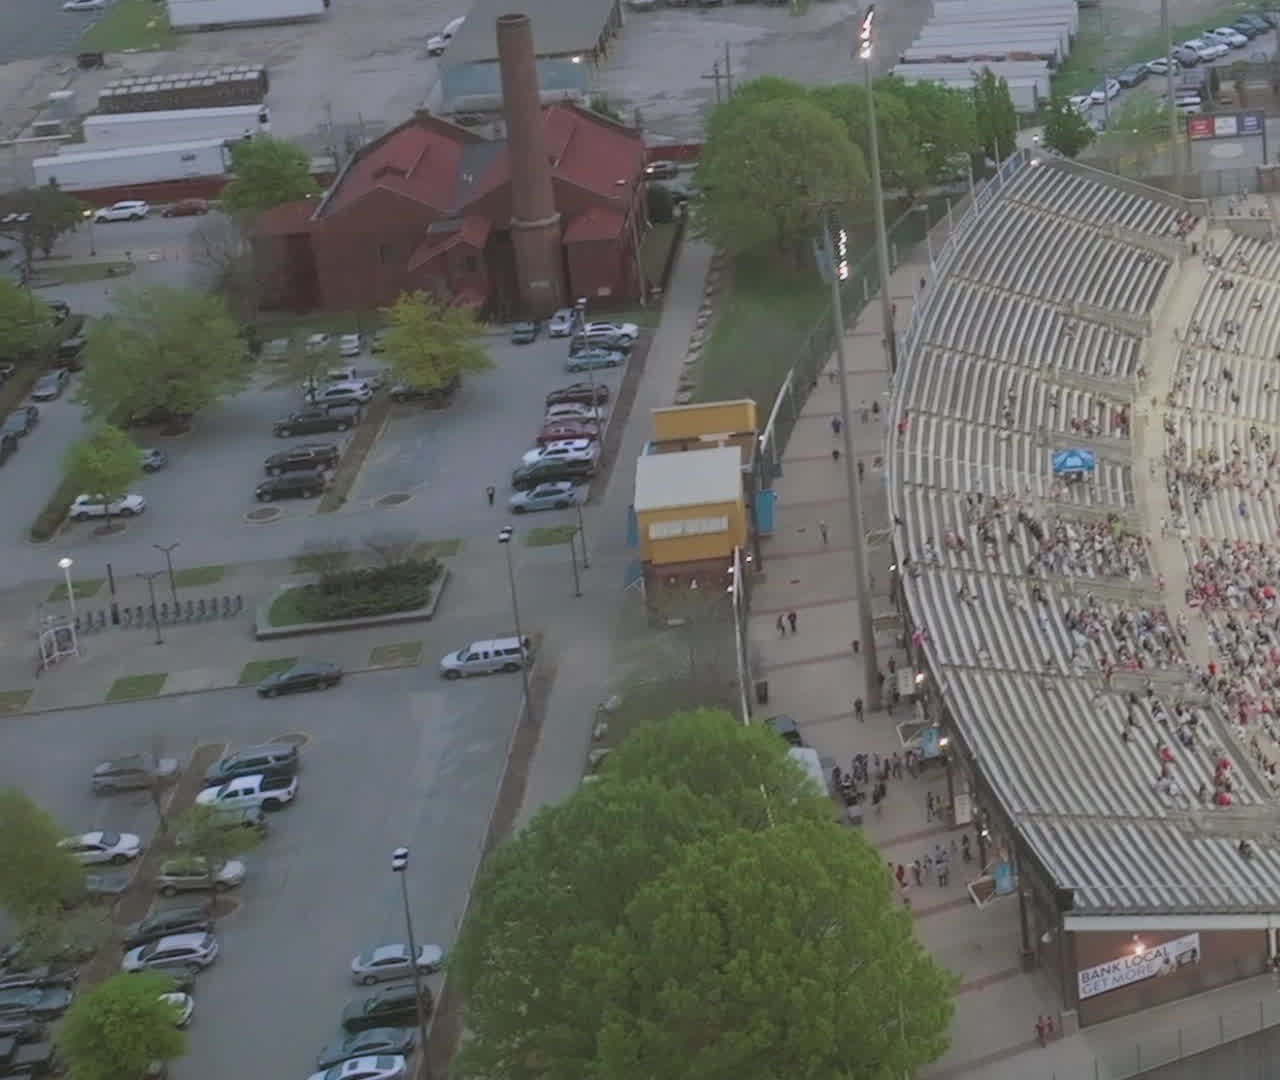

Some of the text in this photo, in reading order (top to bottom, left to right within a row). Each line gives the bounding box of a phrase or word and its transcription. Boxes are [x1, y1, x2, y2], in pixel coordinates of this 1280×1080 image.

[1081, 966, 1154, 995] GET MORE
[1082, 947, 1169, 983] BANK LOCAL
